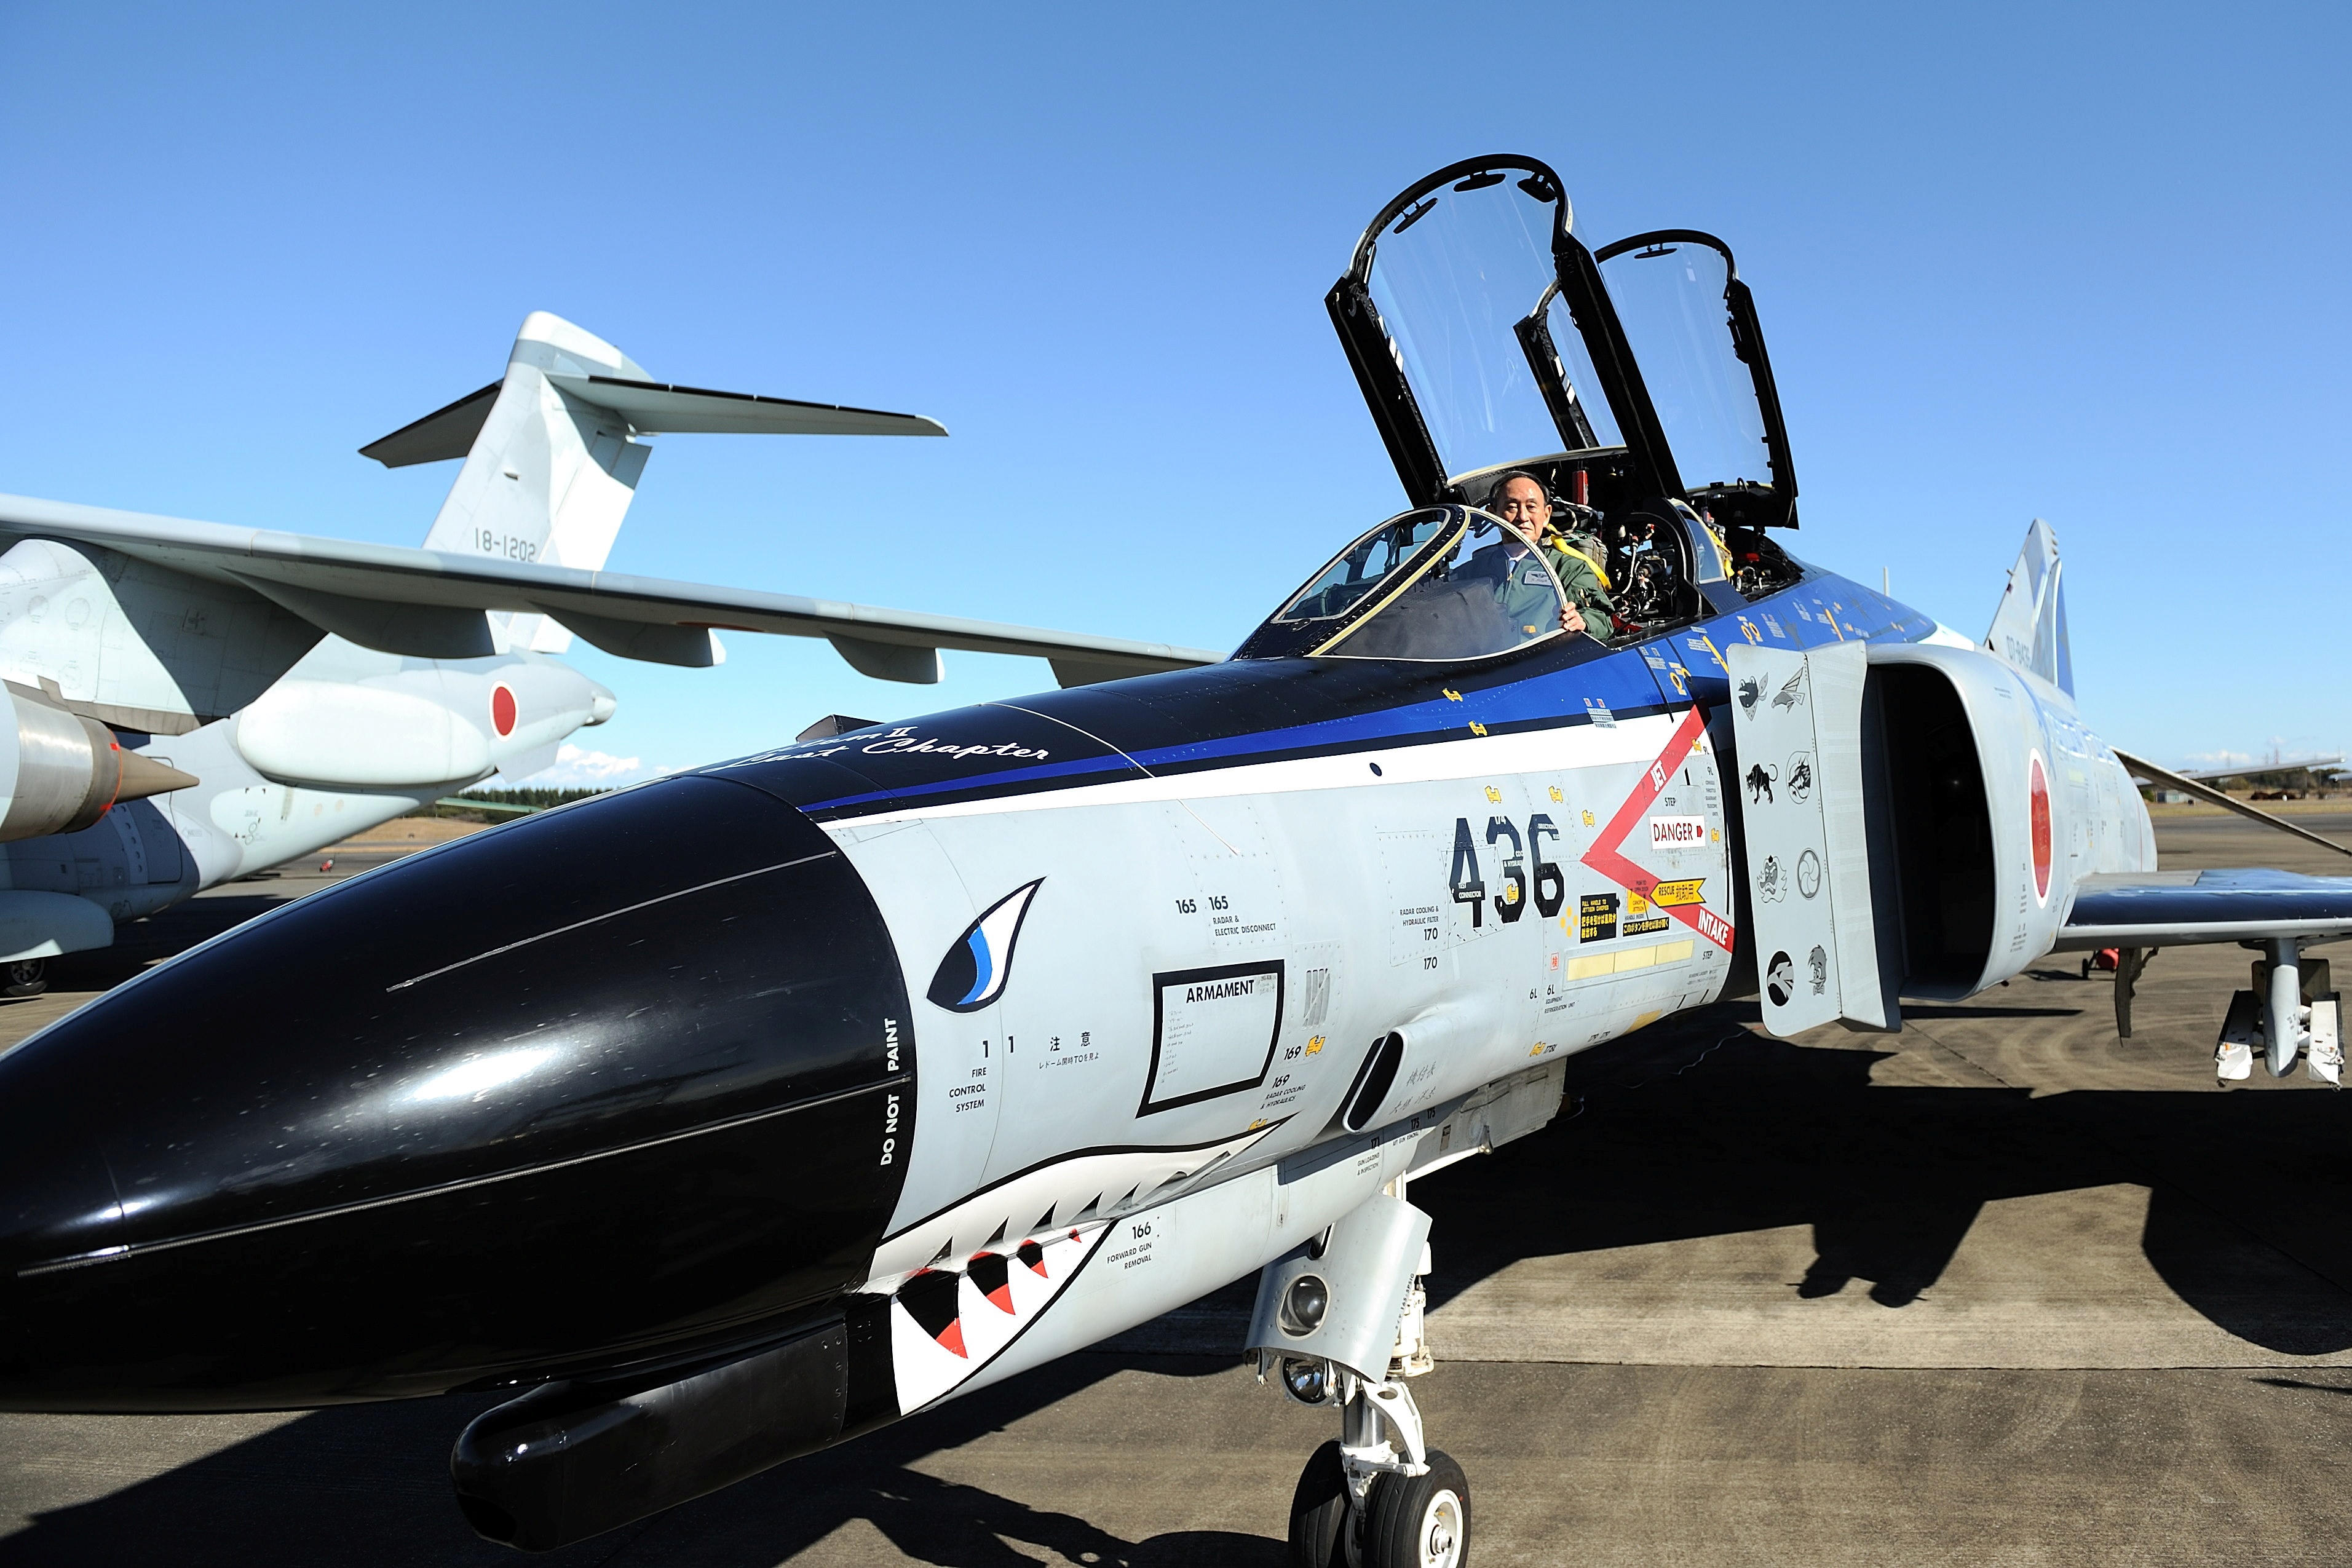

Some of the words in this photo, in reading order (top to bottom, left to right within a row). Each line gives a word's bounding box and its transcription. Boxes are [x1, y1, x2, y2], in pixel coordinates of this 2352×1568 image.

[474, 527, 536, 562] 18-1202
[861, 736, 1048, 761] Chapter
[1650, 760, 1667, 793] JET
[1665, 798, 1676, 807] STEP
[1653, 823, 1693, 842] DANGER
[1449, 813, 1564, 928] 436
[1459, 890, 1482, 900] CONNECTOR
[1658, 885, 1675, 896] RESCUE
[1176, 898, 1197, 914] 165
[1209, 895, 1229, 911] 165
[1400, 907, 1415, 916] RADAR
[1416, 906, 1434, 915] COOLING
[1213, 915, 1232, 925] RADAR
[1403, 917, 1426, 927] HYDRAULIC
[1698, 909, 1728, 946] INTAKE
[1215, 926, 1239, 936] ELECTRIC
[1241, 923, 1276, 934] DISCONNECT
[1423, 928, 1438, 941] 170
[1702, 950, 1713, 960] STEP
[1423, 957, 1438, 970] 170
[1186, 980, 1254, 1004] ARMAMENT
[1547, 984, 1555, 996] 6L
[884, 1018, 900, 1072] PAINT
[983, 1040, 989, 1058] 1
[1008, 1036, 1015, 1054] 1
[1283, 1045, 1302, 1061] 169
[972, 1067, 987, 1078] FIRE
[1272, 1074, 1291, 1089] 169
[949, 1083, 986, 1098] CONTROL
[1265, 1091, 1283, 1101] RADAR
[1283, 1084, 1307, 1096] COOLING
[956, 1099, 984, 1112] SYSTEM
[1265, 1095, 1297, 1109] HYDRAULICS
[885, 1095, 900, 1133] NOT
[1427, 1106, 1436, 1119] 175
[1411, 1117, 1420, 1130] 175
[1371, 1136, 1380, 1150] 171
[881, 1138, 896, 1166] DO
[1357, 1158, 1366, 1167] GUN
[1365, 1152, 1380, 1164] LOADING
[1360, 1162, 1379, 1174] INSPECTION
[1132, 1221, 1152, 1240] 166
[1107, 1247, 1138, 1265] FORWARD
[1139, 1241, 1152, 1253] GUN
[1123, 1254, 1152, 1270] REMOVAL
